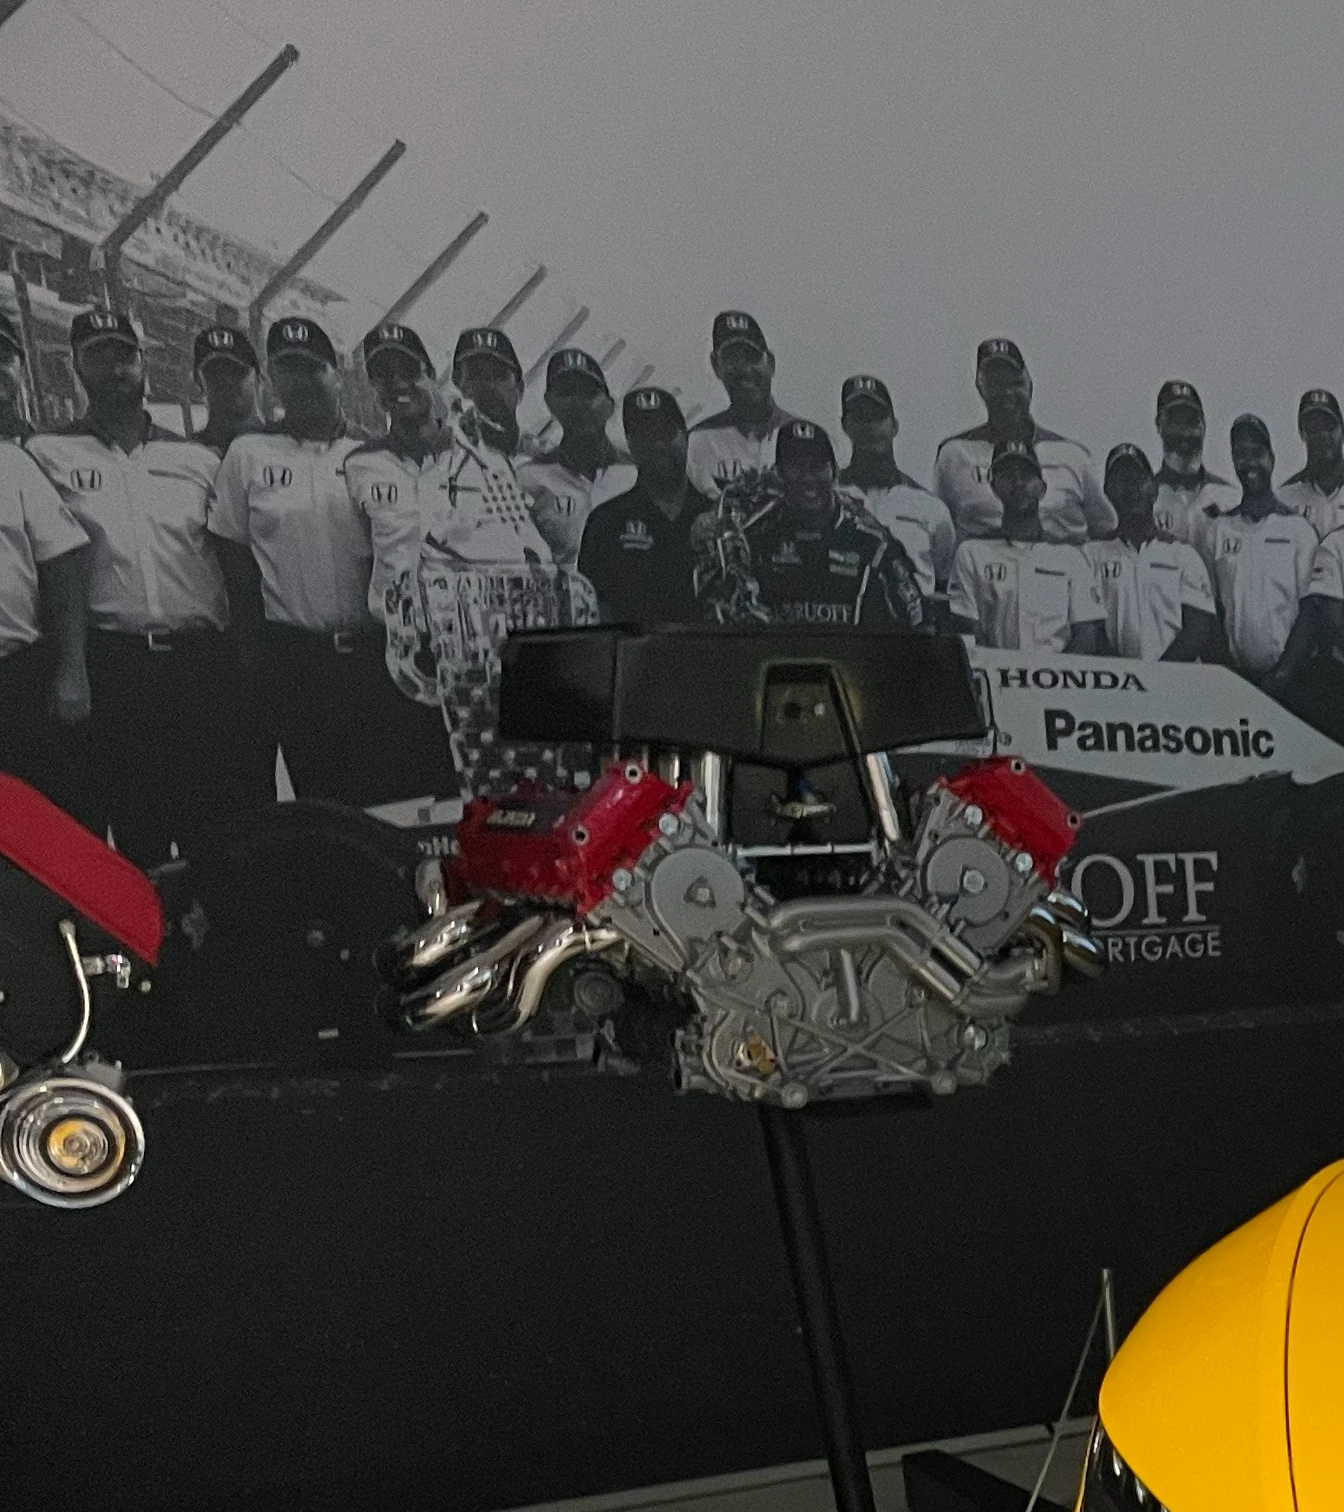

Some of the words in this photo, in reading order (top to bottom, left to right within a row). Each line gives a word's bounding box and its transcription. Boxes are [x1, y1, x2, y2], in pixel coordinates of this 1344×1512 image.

[996, 667, 1149, 692] HONDA
[1044, 707, 1275, 759] Panasonic
[1071, 851, 1218, 928] OFF
[1098, 930, 1222, 964] RTGAGE
